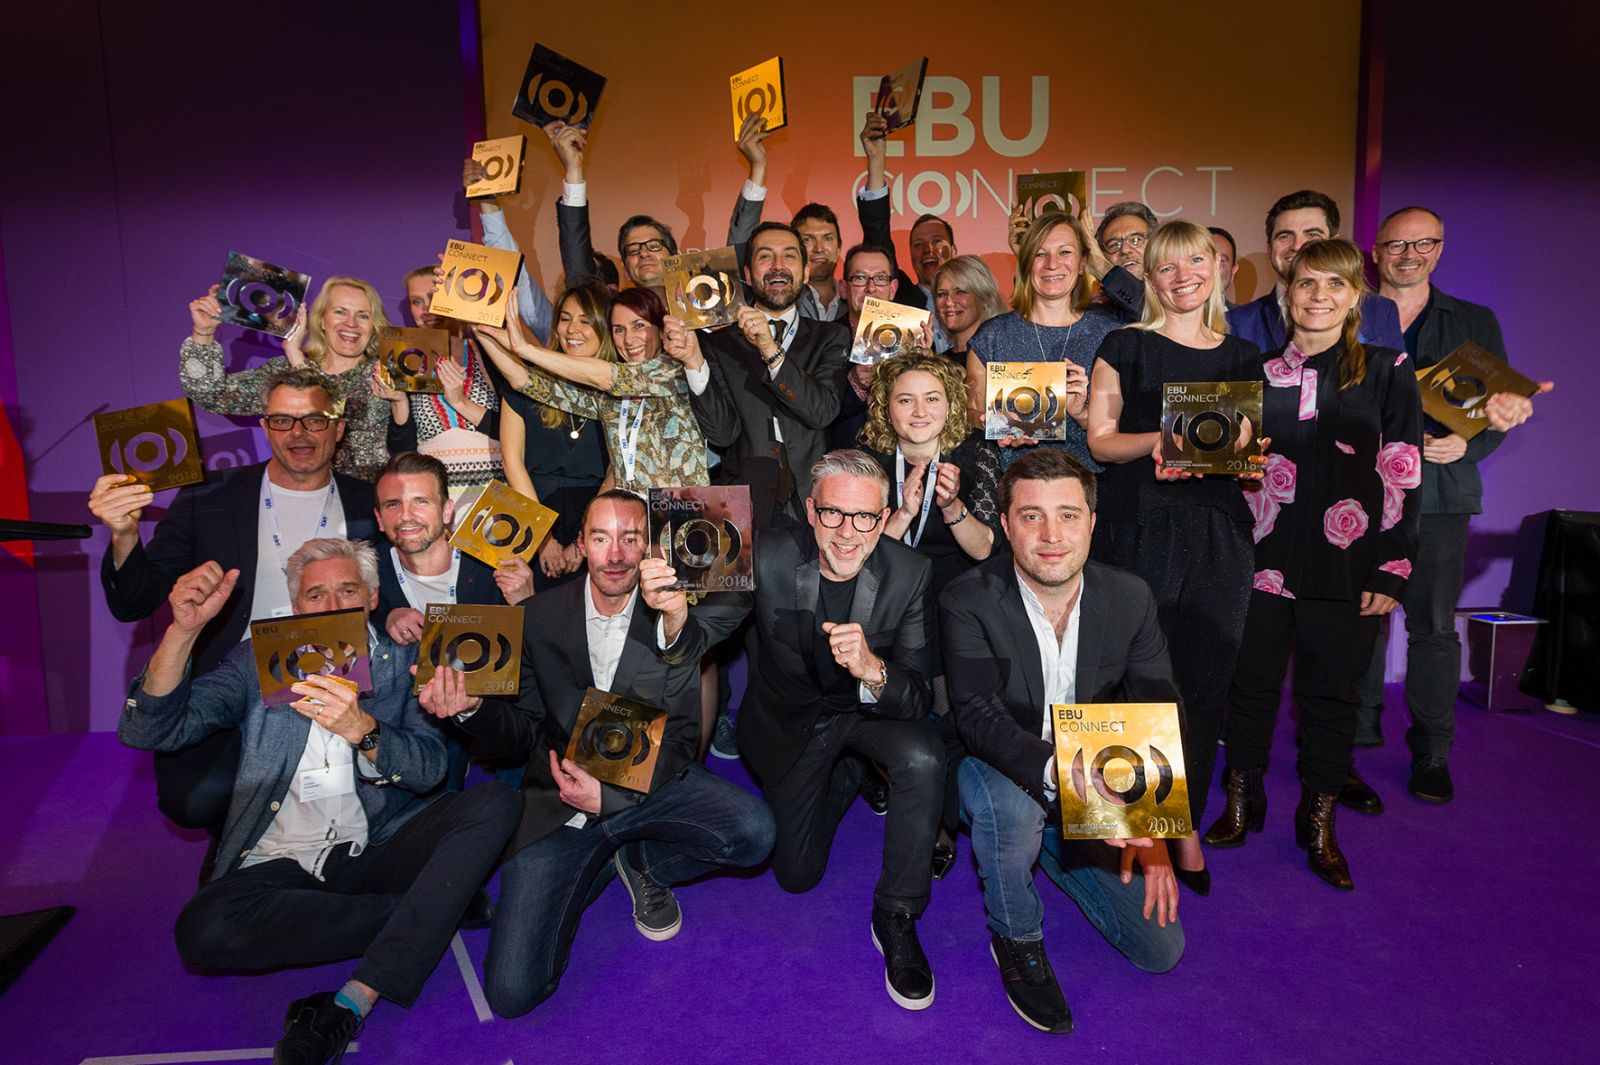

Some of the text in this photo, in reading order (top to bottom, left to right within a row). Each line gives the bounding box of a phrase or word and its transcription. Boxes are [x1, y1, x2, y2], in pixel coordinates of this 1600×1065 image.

[731, 76, 742, 84] EBU
[732, 74, 760, 90] CONNECT
[853, 75, 1050, 158] EBU
[475, 145, 502, 154] CONNECT
[1020, 181, 1058, 189] CONNECT
[851, 165, 1234, 218] CONECT
[449, 242, 465, 252] EBU
[447, 250, 489, 263] CONNECT
[663, 257, 680, 267] EBU
[866, 299, 881, 308] EBU
[477, 311, 501, 325] 2018
[989, 365, 1006, 373] EBU
[1167, 386, 1187, 395] EBU
[1167, 394, 1220, 404] CONNECT
[1226, 459, 1258, 471] 2018
[168, 470, 199, 483] 2018
[650, 490, 673, 500] EBU
[650, 499, 707, 512] CONNECT
[718, 575, 749, 588] 2018
[428, 606, 450, 615] EBU
[428, 614, 484, 624] CONNECT
[255, 626, 279, 635] EBU
[485, 680, 515, 692] 2018
[1058, 709, 1083, 720] EBU
[1059, 720, 1127, 732] CONNECT
[1147, 816, 1187, 833] 2018
